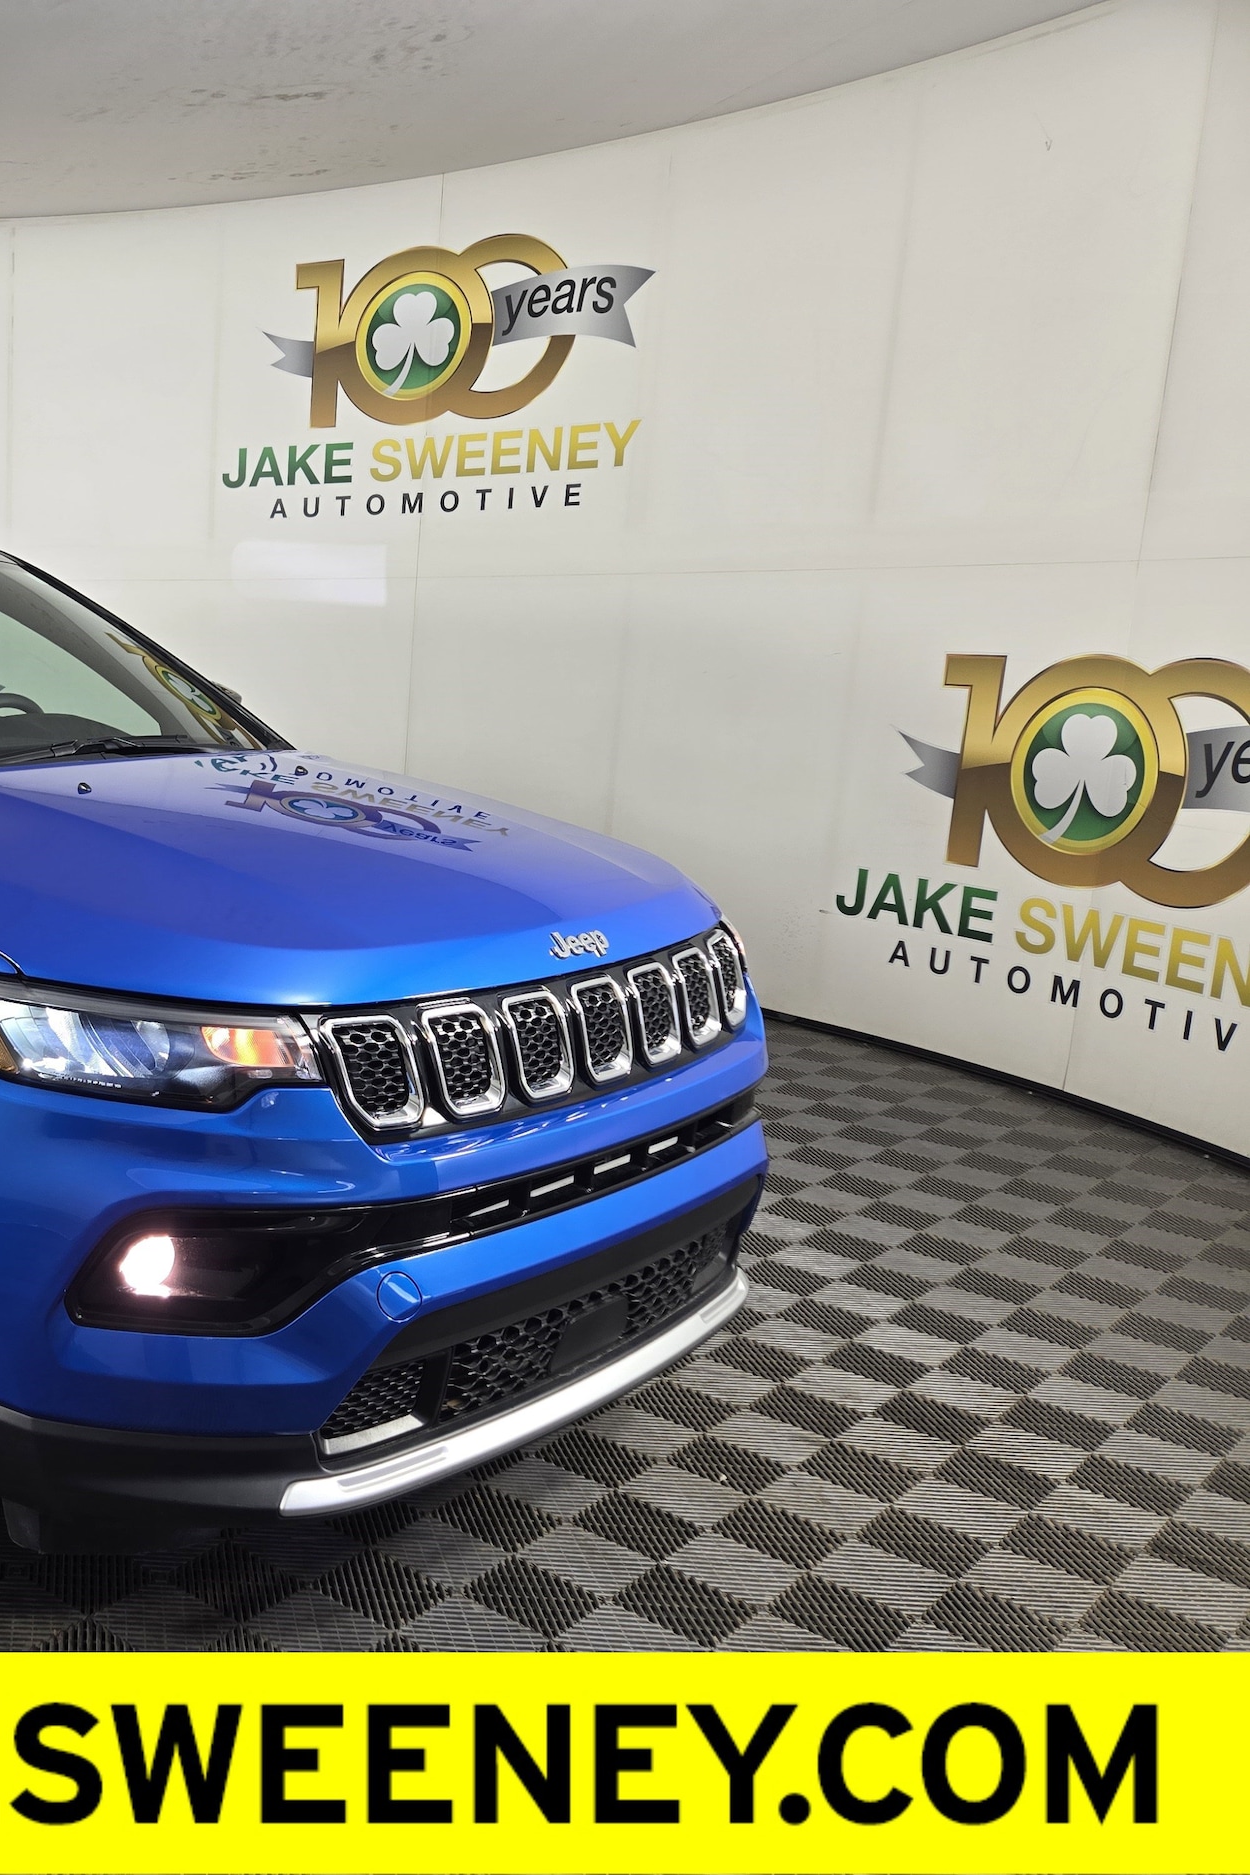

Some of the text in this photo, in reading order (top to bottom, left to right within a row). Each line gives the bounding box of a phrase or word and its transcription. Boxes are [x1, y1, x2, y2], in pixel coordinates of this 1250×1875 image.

[295, 233, 576, 428] 100
[502, 275, 617, 336] years
[222, 419, 642, 489] JAKE SWEENEY
[270, 483, 582, 519] AUTOMOTIVE
[943, 653, 1250, 908] 100
[549, 930, 609, 960] Jeep
[836, 868, 1250, 1009] JAKE SWEEN
[888, 940, 1238, 1052] AUTOMOTIV
